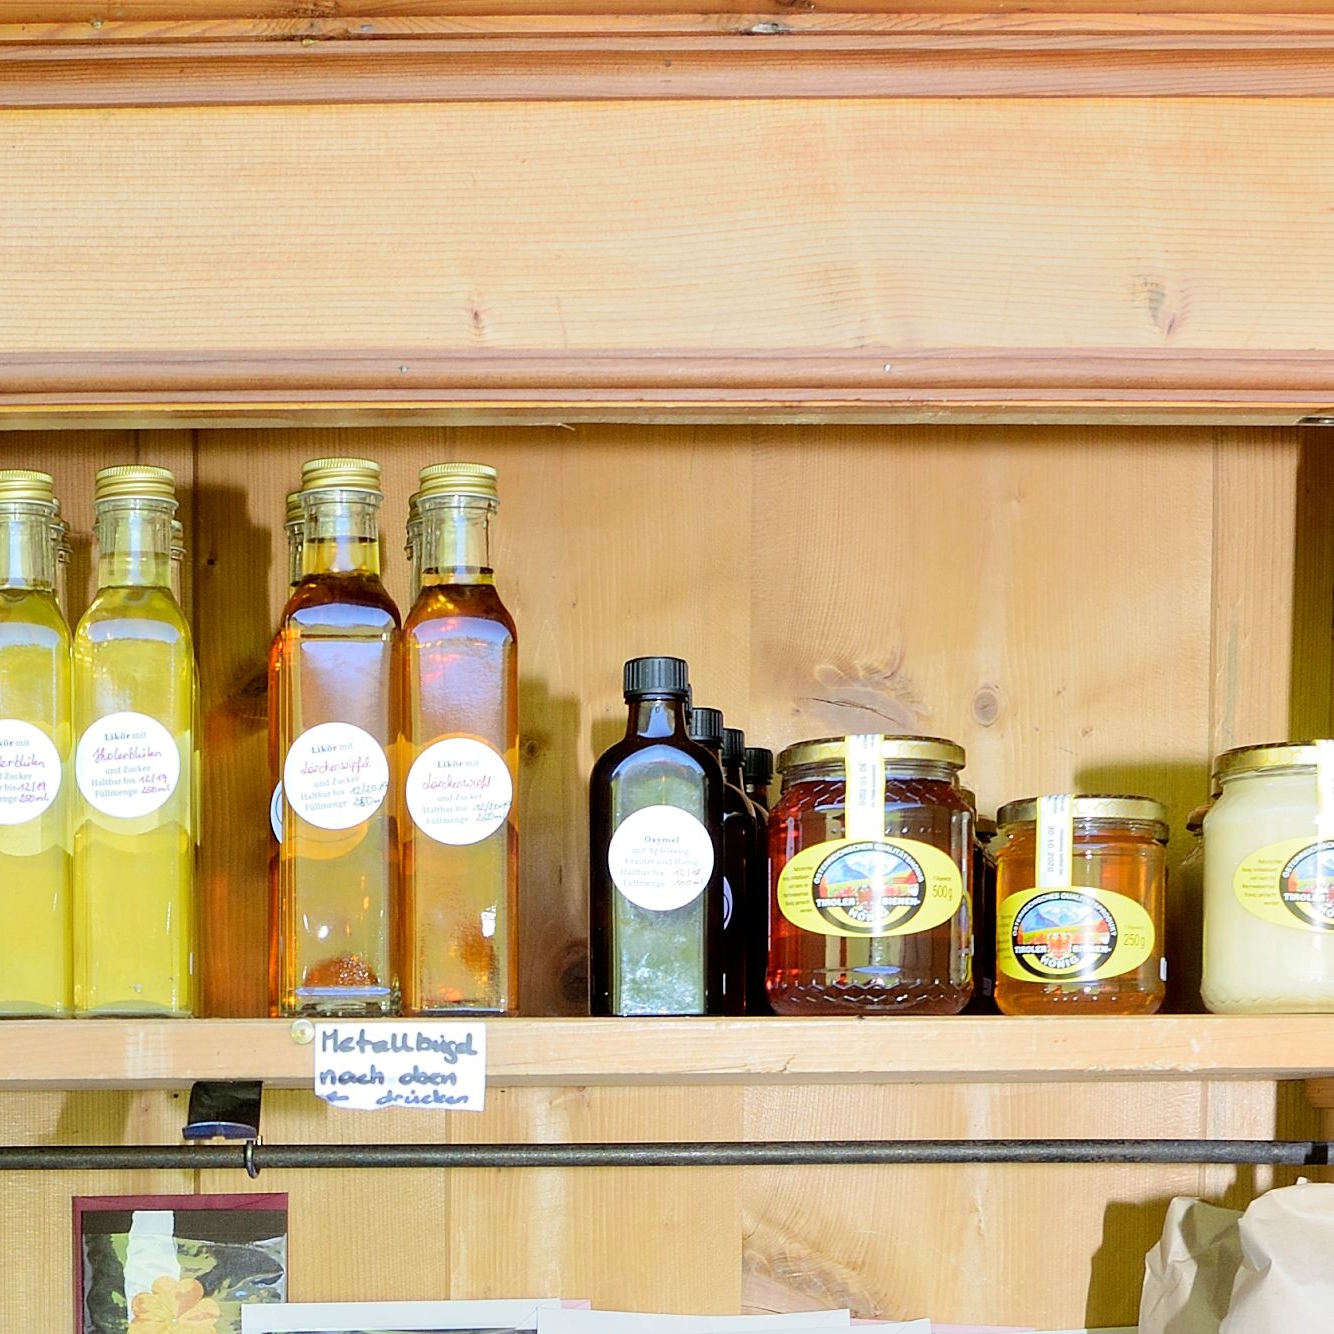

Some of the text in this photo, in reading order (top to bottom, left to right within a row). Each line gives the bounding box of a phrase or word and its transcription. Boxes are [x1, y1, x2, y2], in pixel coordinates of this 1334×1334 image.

[104, 733, 130, 741] Likör
[311, 743, 353, 754] Likör mit
[437, 760, 463, 768] Likör
[124, 765, 150, 773] Zucker
[91, 778, 122, 787] Haltbar
[332, 776, 359, 785] Zucker
[320, 1065, 457, 1085] nach oben
[376, 1089, 468, 1104] drücken
